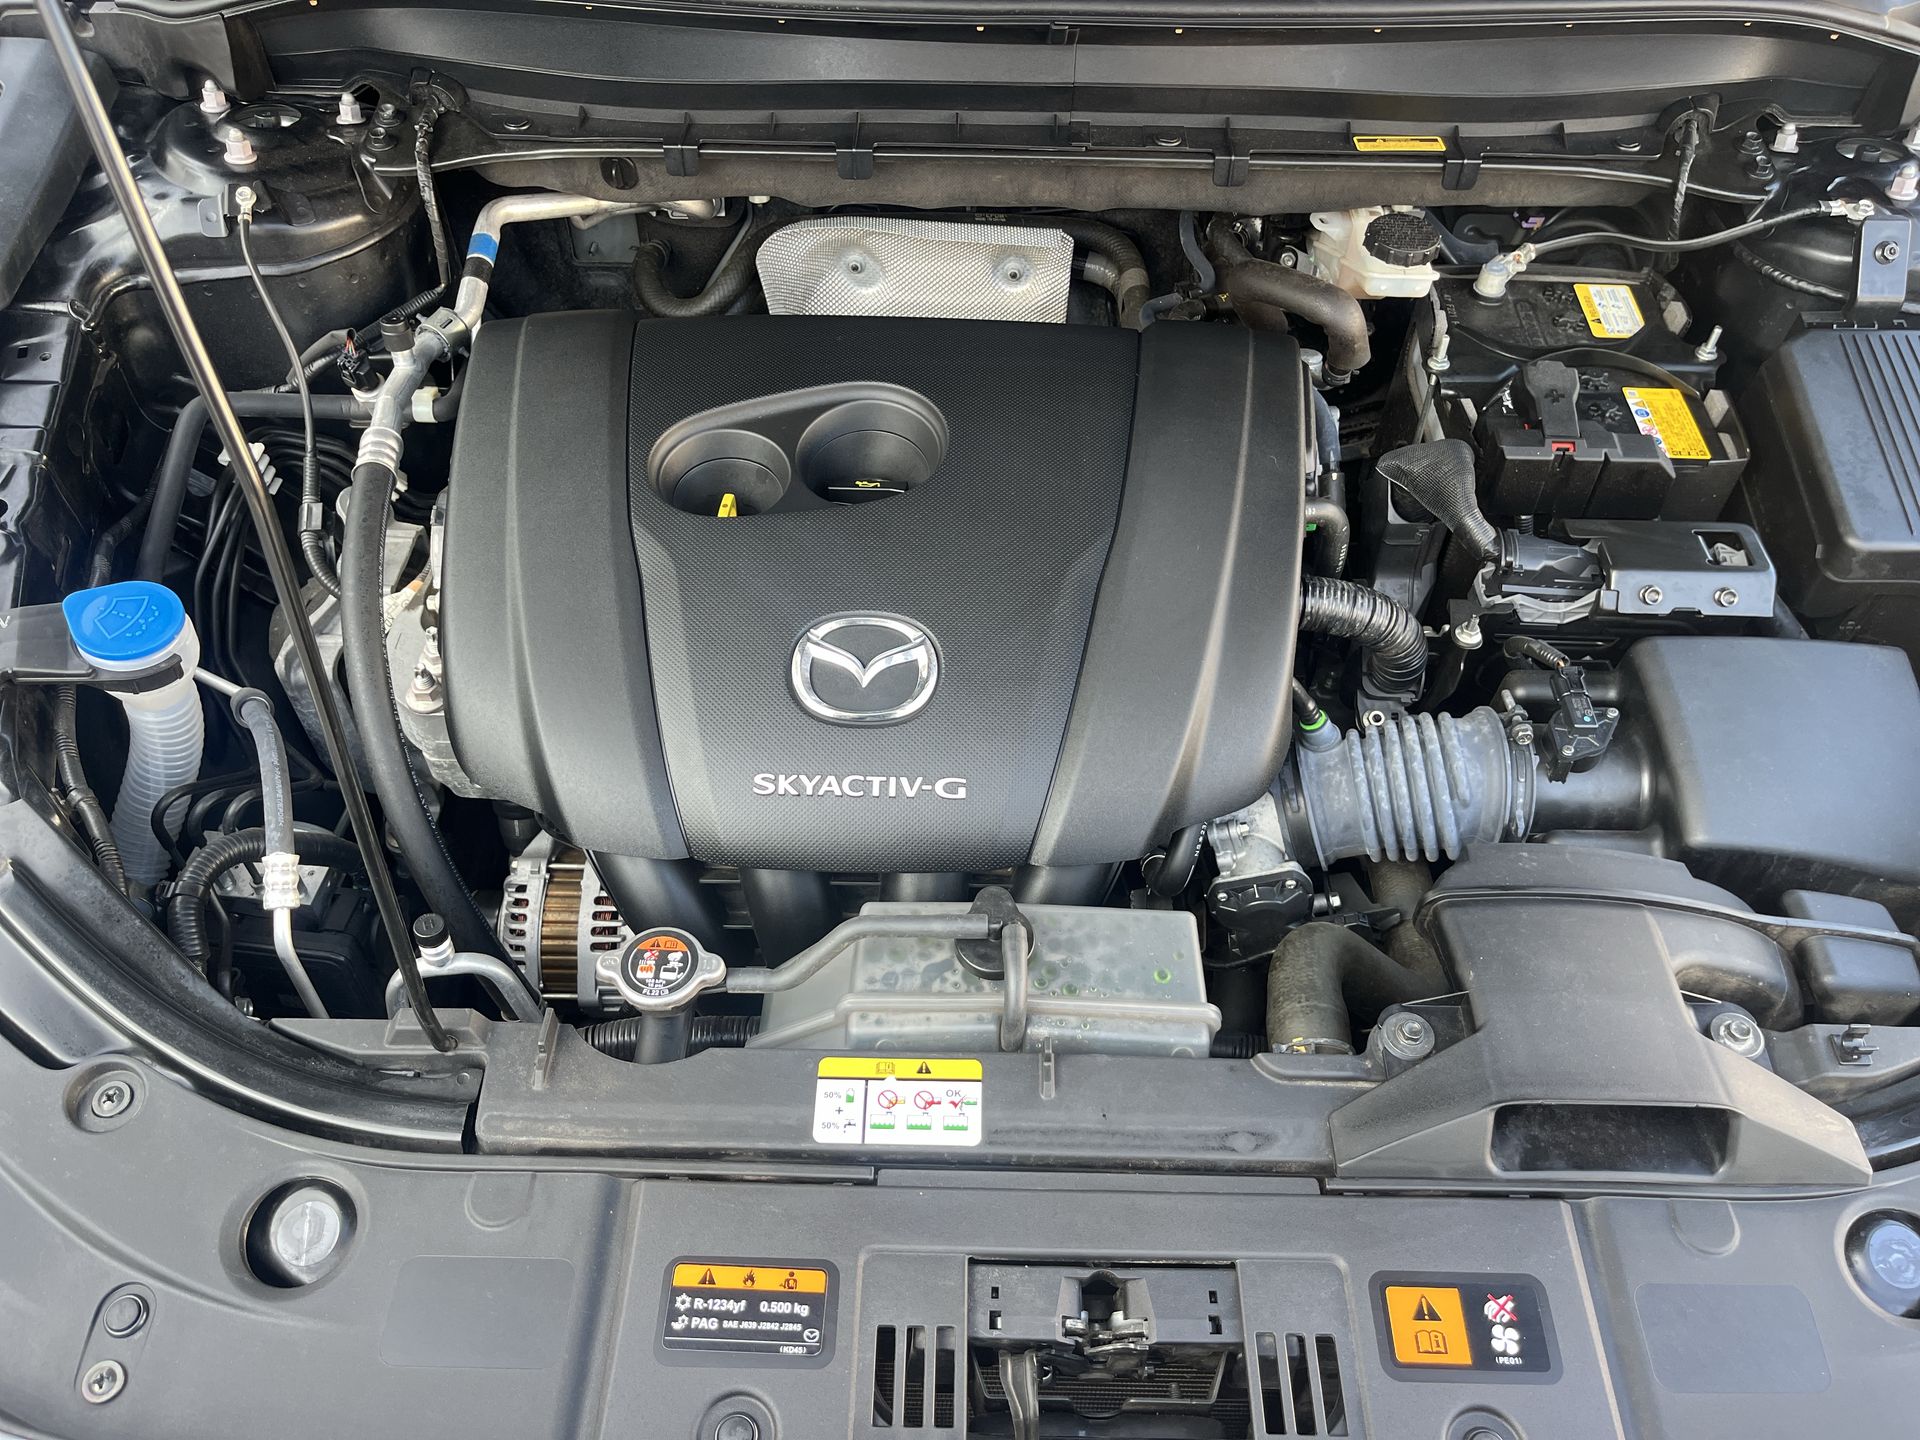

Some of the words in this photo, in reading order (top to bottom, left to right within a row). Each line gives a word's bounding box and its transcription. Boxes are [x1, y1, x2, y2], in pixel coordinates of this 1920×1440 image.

[752, 773, 967, 799] SKYACTIV-G
[823, 1091, 842, 1099] 50%
[945, 1089, 962, 1098] OK
[821, 1121, 840, 1130] 50%
[693, 1297, 747, 1314] R-1234yf
[759, 1300, 792, 1314] 0.500
[793, 1301, 810, 1317] kg
[690, 1317, 719, 1330] PAG
[722, 1319, 739, 1329] SAE
[739, 1320, 757, 1330] J639
[757, 1321, 780, 1331] J2842
[780, 1322, 802, 1331] J2845
[780, 1346, 807, 1354] (KD45)
[1495, 1356, 1523, 1365] (PE01)
